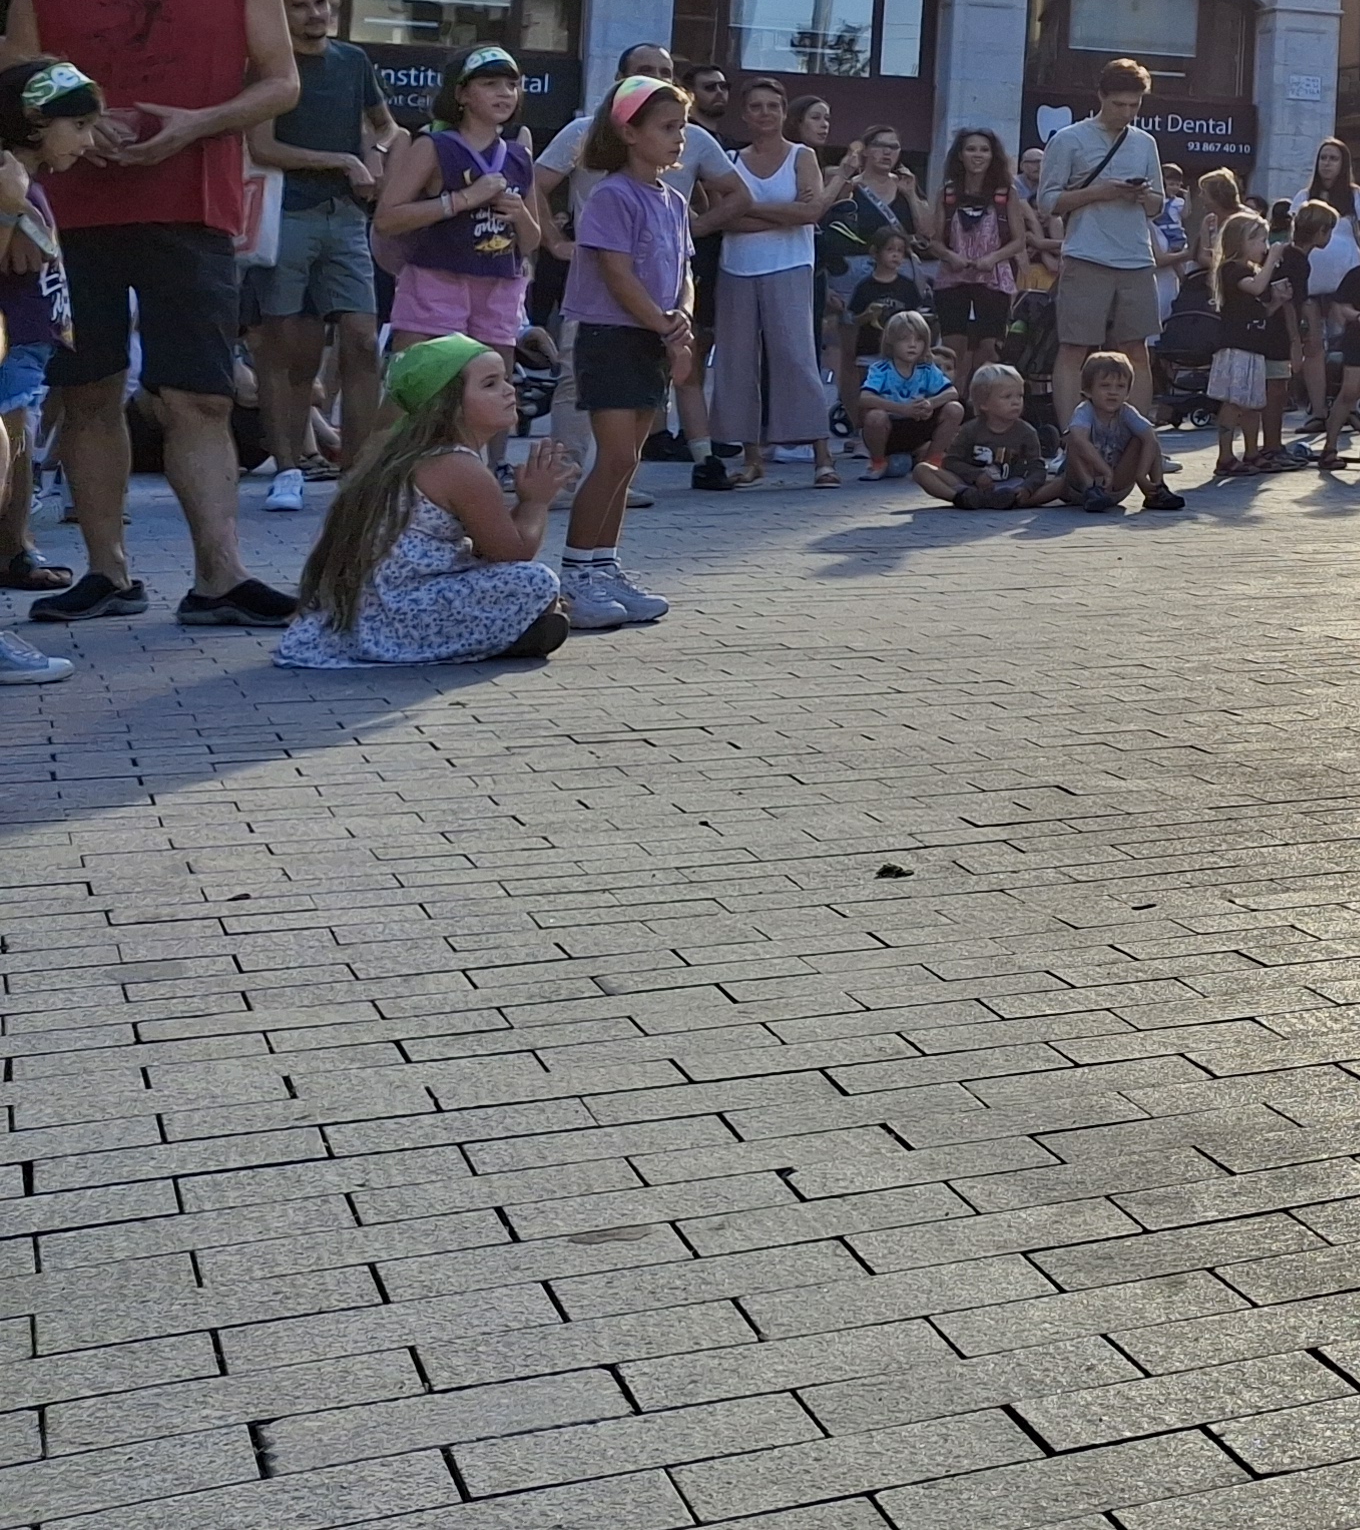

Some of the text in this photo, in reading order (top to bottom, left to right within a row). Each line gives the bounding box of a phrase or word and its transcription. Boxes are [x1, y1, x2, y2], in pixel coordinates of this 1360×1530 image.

[1167, 113, 1233, 135] Dental
[1187, 141, 1251, 154] 93 867 40 10
